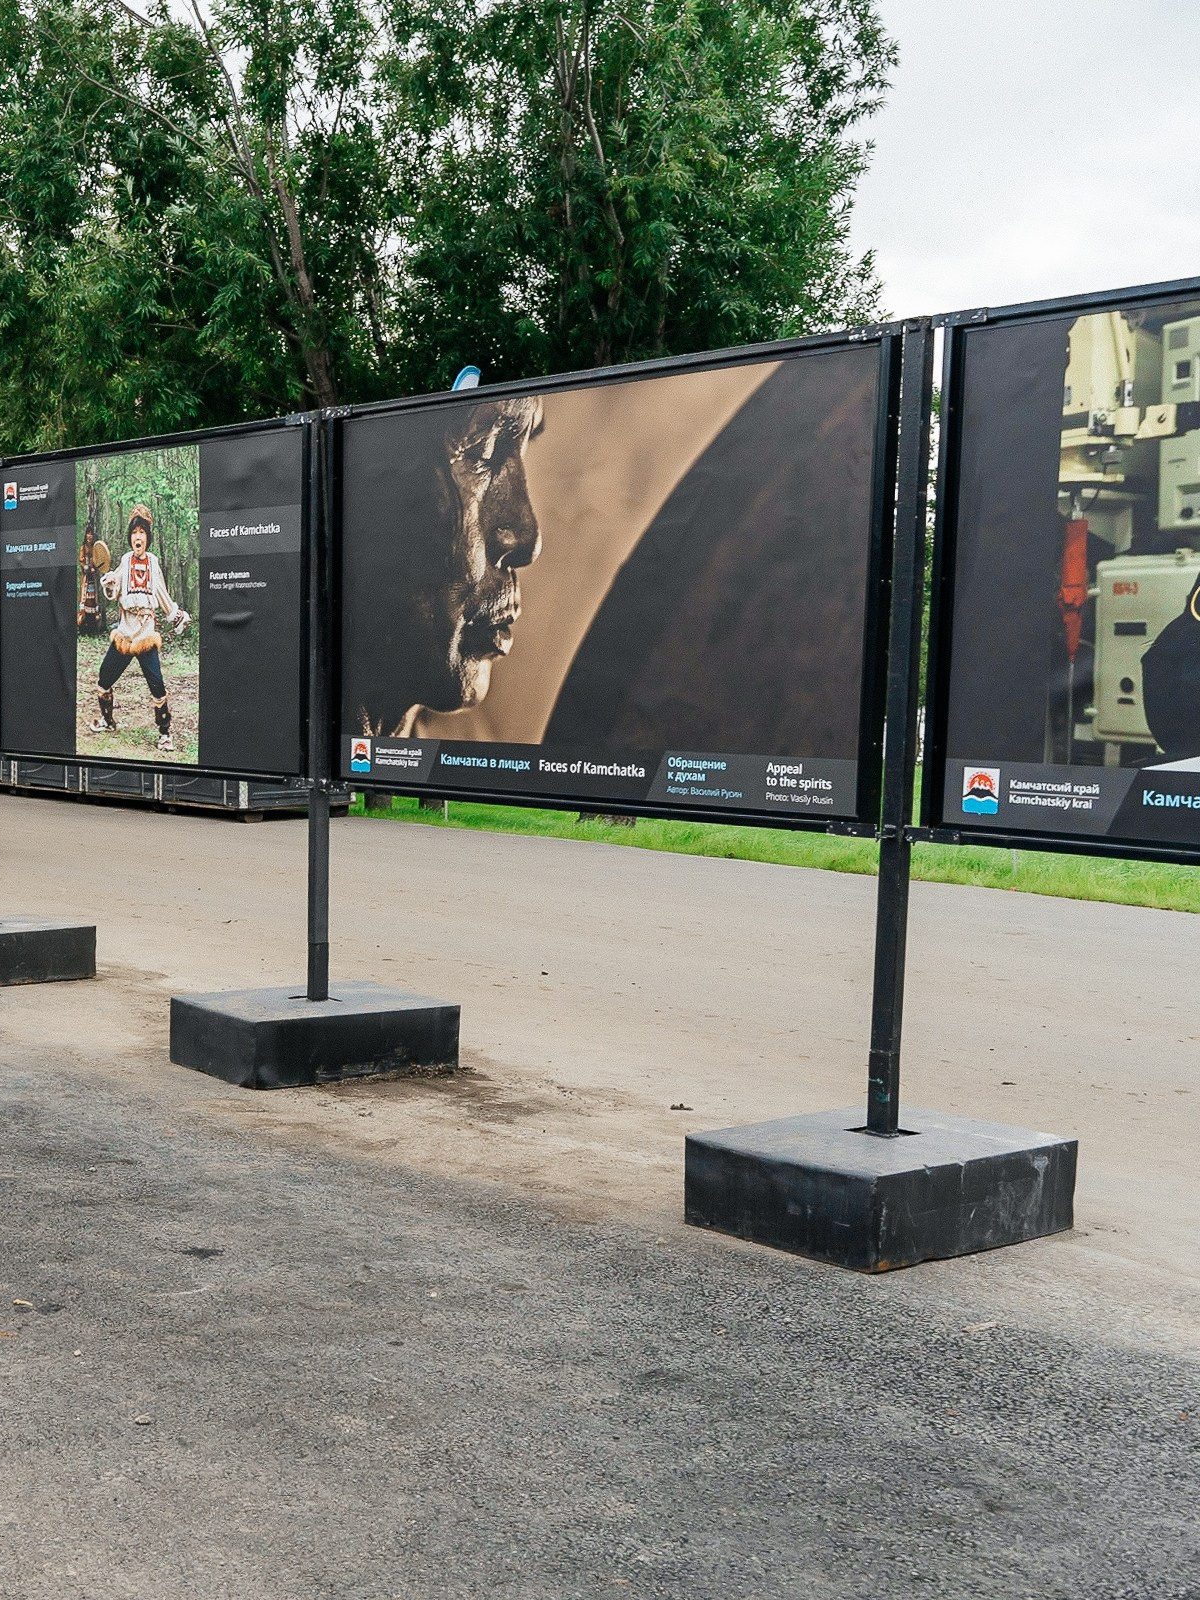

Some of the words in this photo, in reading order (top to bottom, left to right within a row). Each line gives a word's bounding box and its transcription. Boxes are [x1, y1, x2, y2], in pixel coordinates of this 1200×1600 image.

[209, 527, 229, 538] Faces
[230, 525, 238, 537] of
[239, 522, 281, 536] Kamchatka
[5, 543, 33, 553] Камчатка
[38, 542, 56, 552] лицах
[209, 571, 228, 580] Future
[228, 571, 250, 580] shaman
[440, 753, 488, 768] Камчатка
[489, 758, 497, 768] в
[497, 759, 531, 773] лицах
[538, 759, 571, 773] Faces
[571, 760, 582, 774] of
[583, 762, 646, 778] Kamchatka
[667, 756, 727, 771] Обращение
[765, 761, 803, 776] Appeal
[667, 771, 674, 780] к
[674, 771, 706, 783] духам
[765, 775, 778, 787] to
[779, 775, 798, 788] the
[798, 777, 833, 791] spirits
[666, 785, 690, 796] Автор:
[690, 786, 721, 798] Василий
[721, 788, 743, 800] Русин
[1009, 778, 1072, 793] Камчатский
[1072, 782, 1100, 797] край
[765, 791, 789, 802] Photo:
[790, 793, 811, 806] Vasily
[812, 795, 834, 805] Rusin
[1008, 793, 1070, 810] Kamchatskiy
[1071, 797, 1093, 810] krai
[1142, 789, 1200, 809] Камча
